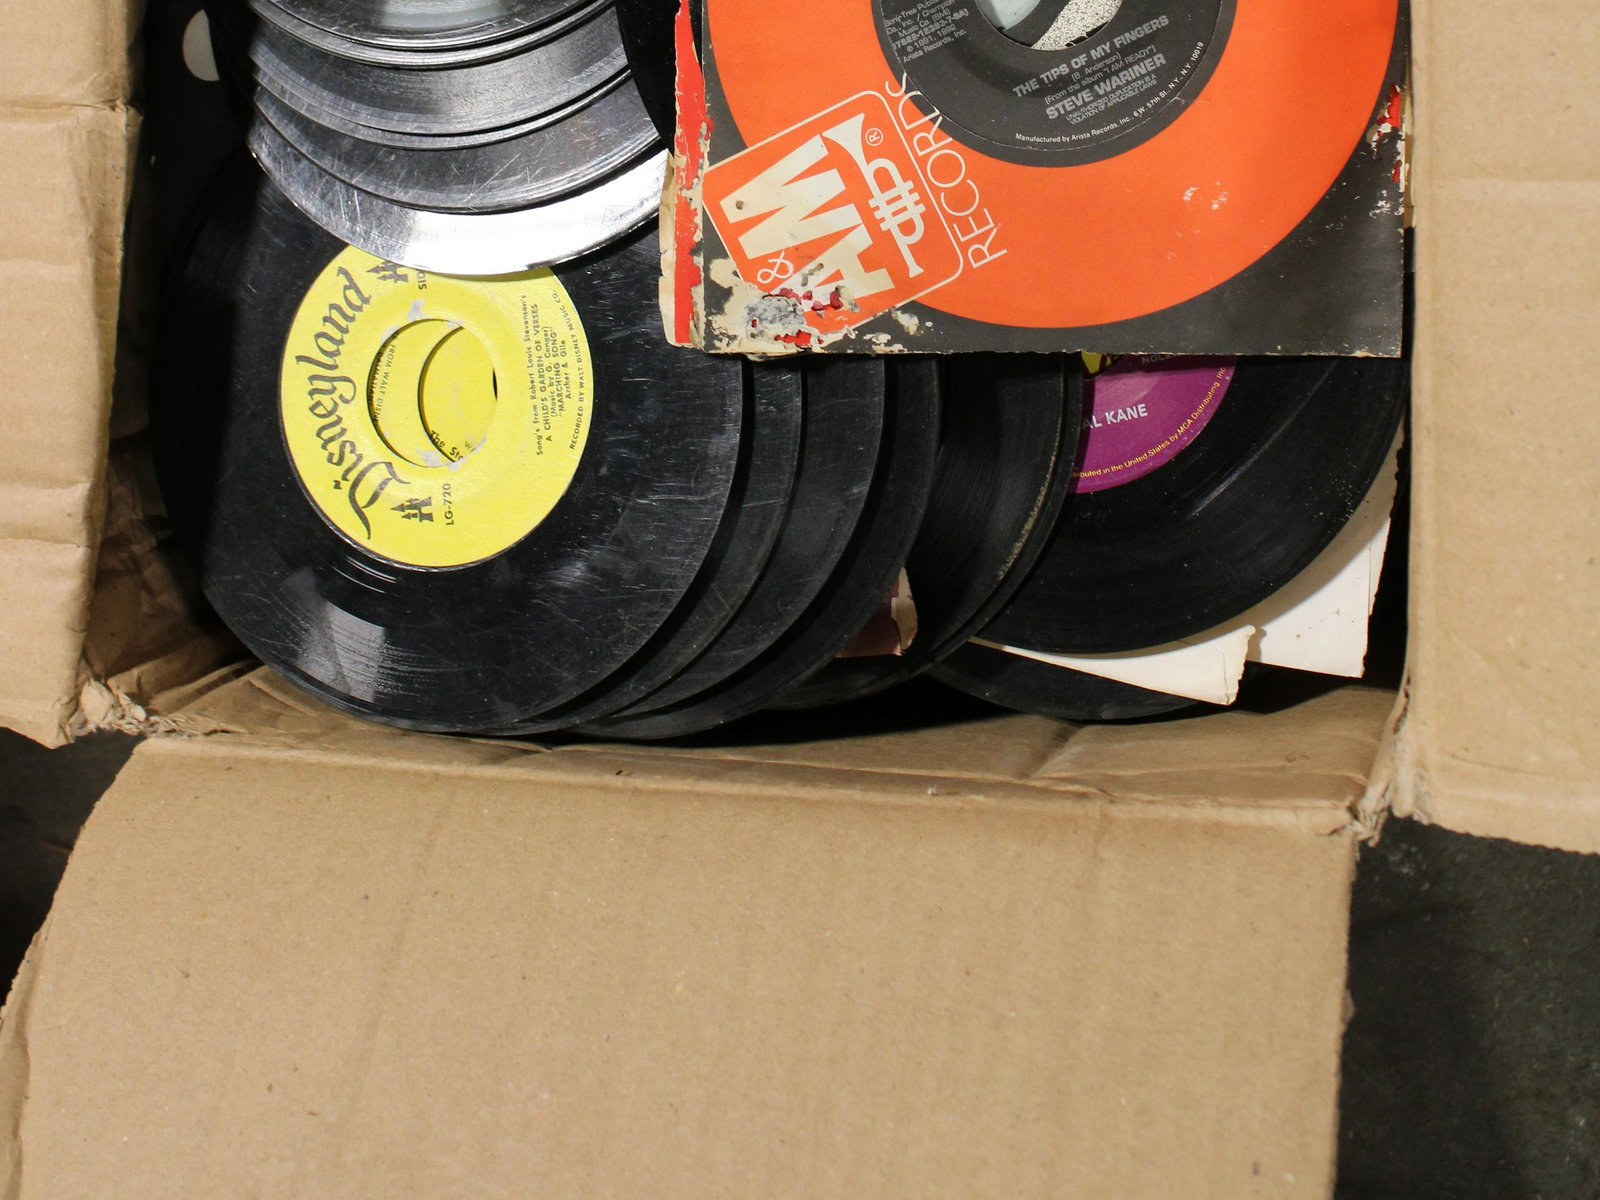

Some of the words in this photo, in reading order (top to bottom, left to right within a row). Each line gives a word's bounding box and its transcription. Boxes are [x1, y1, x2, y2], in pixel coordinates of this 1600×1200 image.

[898, 25, 919, 38] Music
[904, 50, 924, 64] Arista
[1013, 78, 1040, 98] THE
[1040, 64, 1070, 84] TIPS
[1071, 54, 1088, 70] OF
[1092, 42, 1114, 61] MY
[1114, 15, 1170, 50] FINGERS
[1084, 52, 1122, 74] Anderson)
[1016, 133, 1060, 143] Manufactured
[1072, 132, 1090, 140] Arista
[1190, 41, 1204, 62] 10019
[1044, 90, 1067, 106] (From
[1068, 83, 1080, 94] the
[1081, 74, 1102, 88] album
[1110, 62, 1124, 74] AM
[1045, 88, 1094, 120] STEVE
[1094, 53, 1167, 96] WARINER
[885, 71, 1008, 269] RECORDS
[418, 272, 428, 290] SID
[520, 294, 532, 342] Stevenson's
[531, 304, 540, 336] VERSES
[560, 305, 574, 332] MUSIC
[535, 340, 542, 352] OF
[542, 326, 551, 358] Conger)
[570, 334, 582, 363] DISNEY
[526, 346, 534, 368] Louis
[537, 356, 546, 392] GARDEN
[548, 376, 554, 388] by
[563, 372, 572, 400] Archer
[295, 266, 411, 540] Disneyland
[548, 391, 558, 418] (Music
[578, 392, 584, 402] BY
[532, 404, 540, 424] from
[541, 397, 551, 430] CHILD'S
[570, 406, 584, 450] RECORDED
[1105, 403, 1148, 425] KANE
[536, 428, 544, 456] Song's
[1110, 464, 1124, 472] the
[1124, 453, 1148, 468] United
[1148, 440, 1170, 456] States
[1168, 432, 1178, 442] by
[1177, 418, 1194, 436] MCA
[443, 482, 455, 526] LG-720
